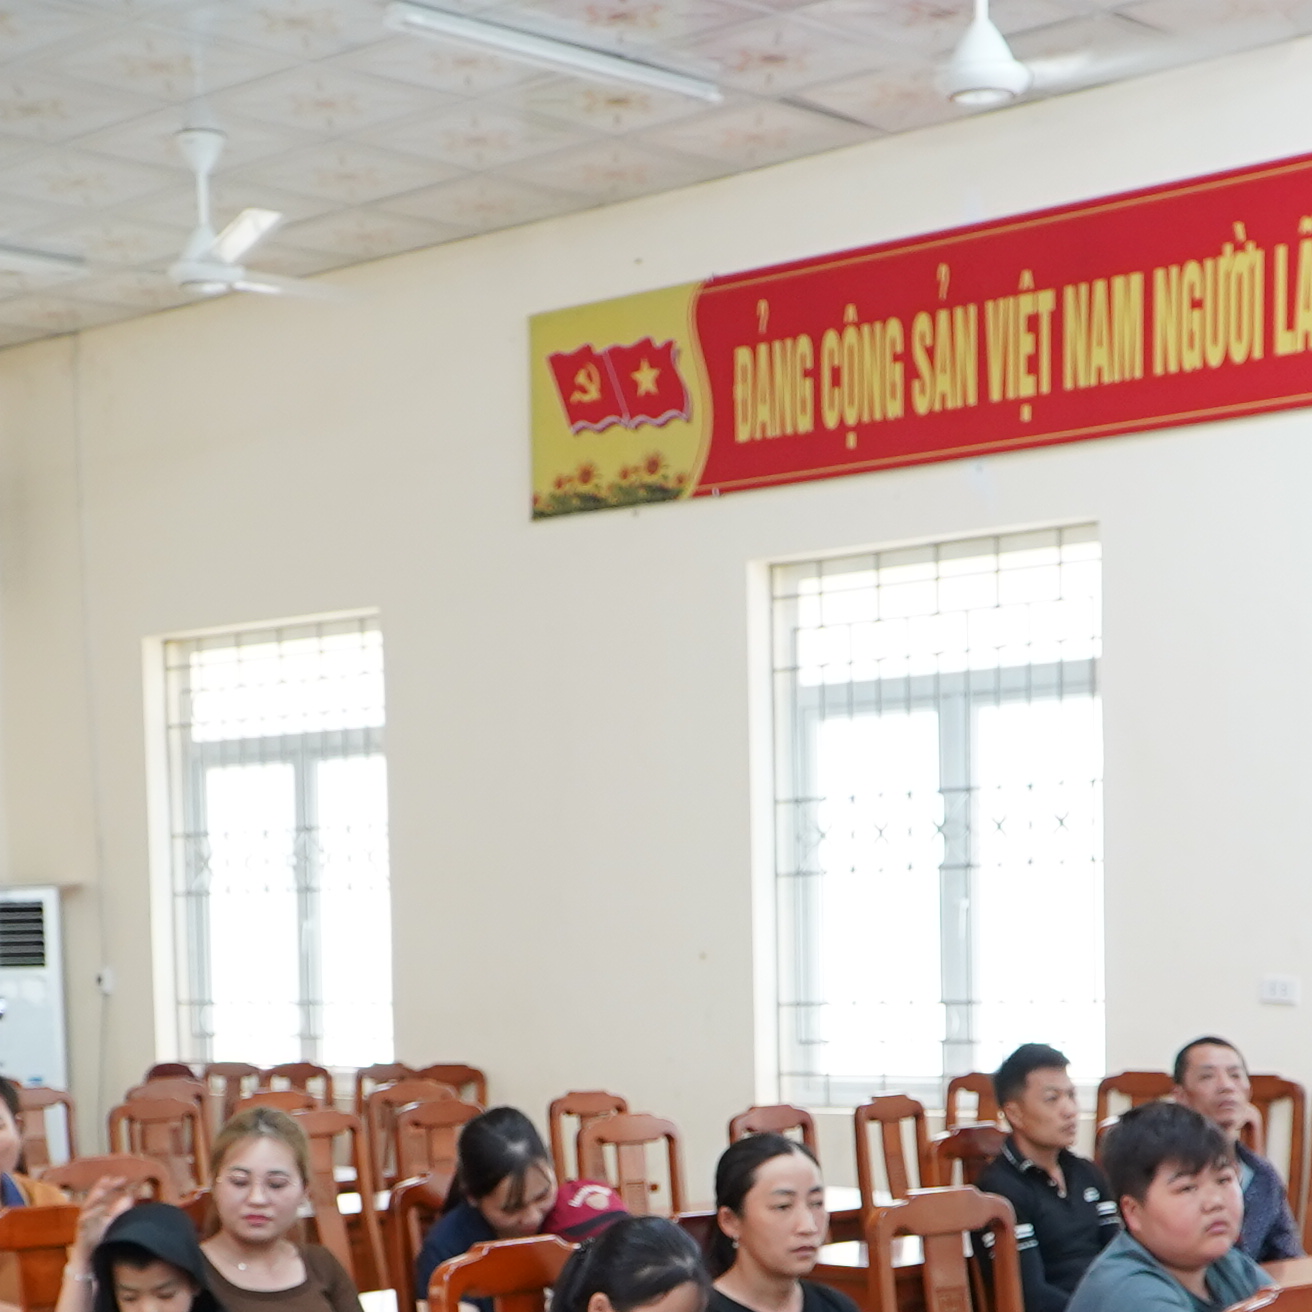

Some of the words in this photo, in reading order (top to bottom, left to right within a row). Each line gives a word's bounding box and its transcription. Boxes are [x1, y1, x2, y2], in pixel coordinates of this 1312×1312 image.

[734, 299, 814, 443] ĐẢNG
[820, 303, 905, 450] CỘNG
[911, 262, 978, 416] SẢN
[985, 269, 1057, 423] VIỆT
[1063, 271, 1145, 391] NAM
[1153, 221, 1265, 377] NGƯỜI
